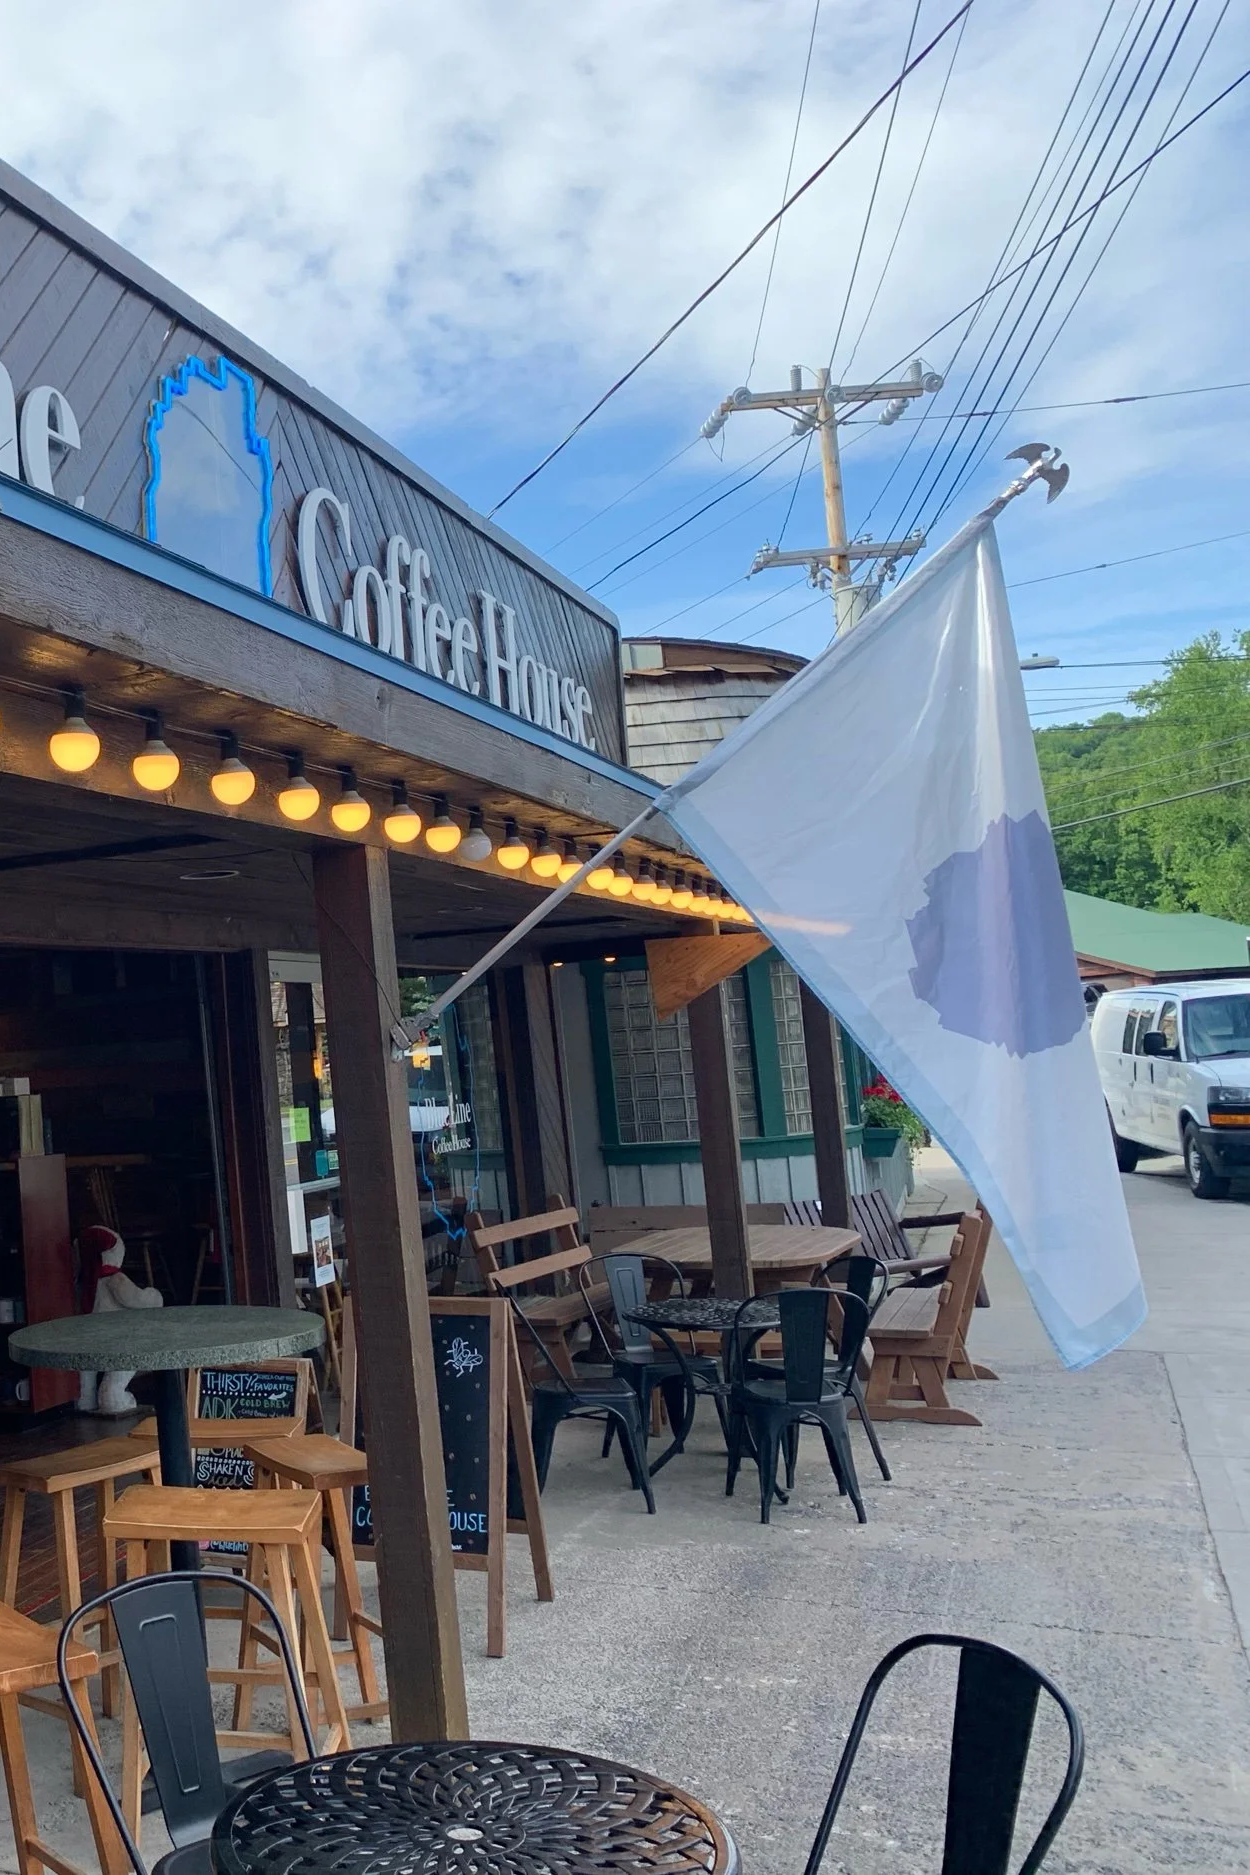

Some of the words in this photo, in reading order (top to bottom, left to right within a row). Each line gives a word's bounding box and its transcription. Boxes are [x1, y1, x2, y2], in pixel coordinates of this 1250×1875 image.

[298, 487, 480, 696] Coffee
[478, 589, 596, 751] House
[448, 1091, 471, 1127] Line
[432, 1136, 452, 1155] Coffee
[451, 1134, 471, 1151] House
[203, 1372, 259, 1392] THIRSTY?
[254, 1382, 295, 1392] FAVORITES
[201, 1396, 239, 1419] ADK
[239, 1398, 262, 1407] COLD
[263, 1399, 291, 1408] BREW
[197, 1461, 243, 1481] SHAKEN
[448, 1511, 488, 1533] OUSE
